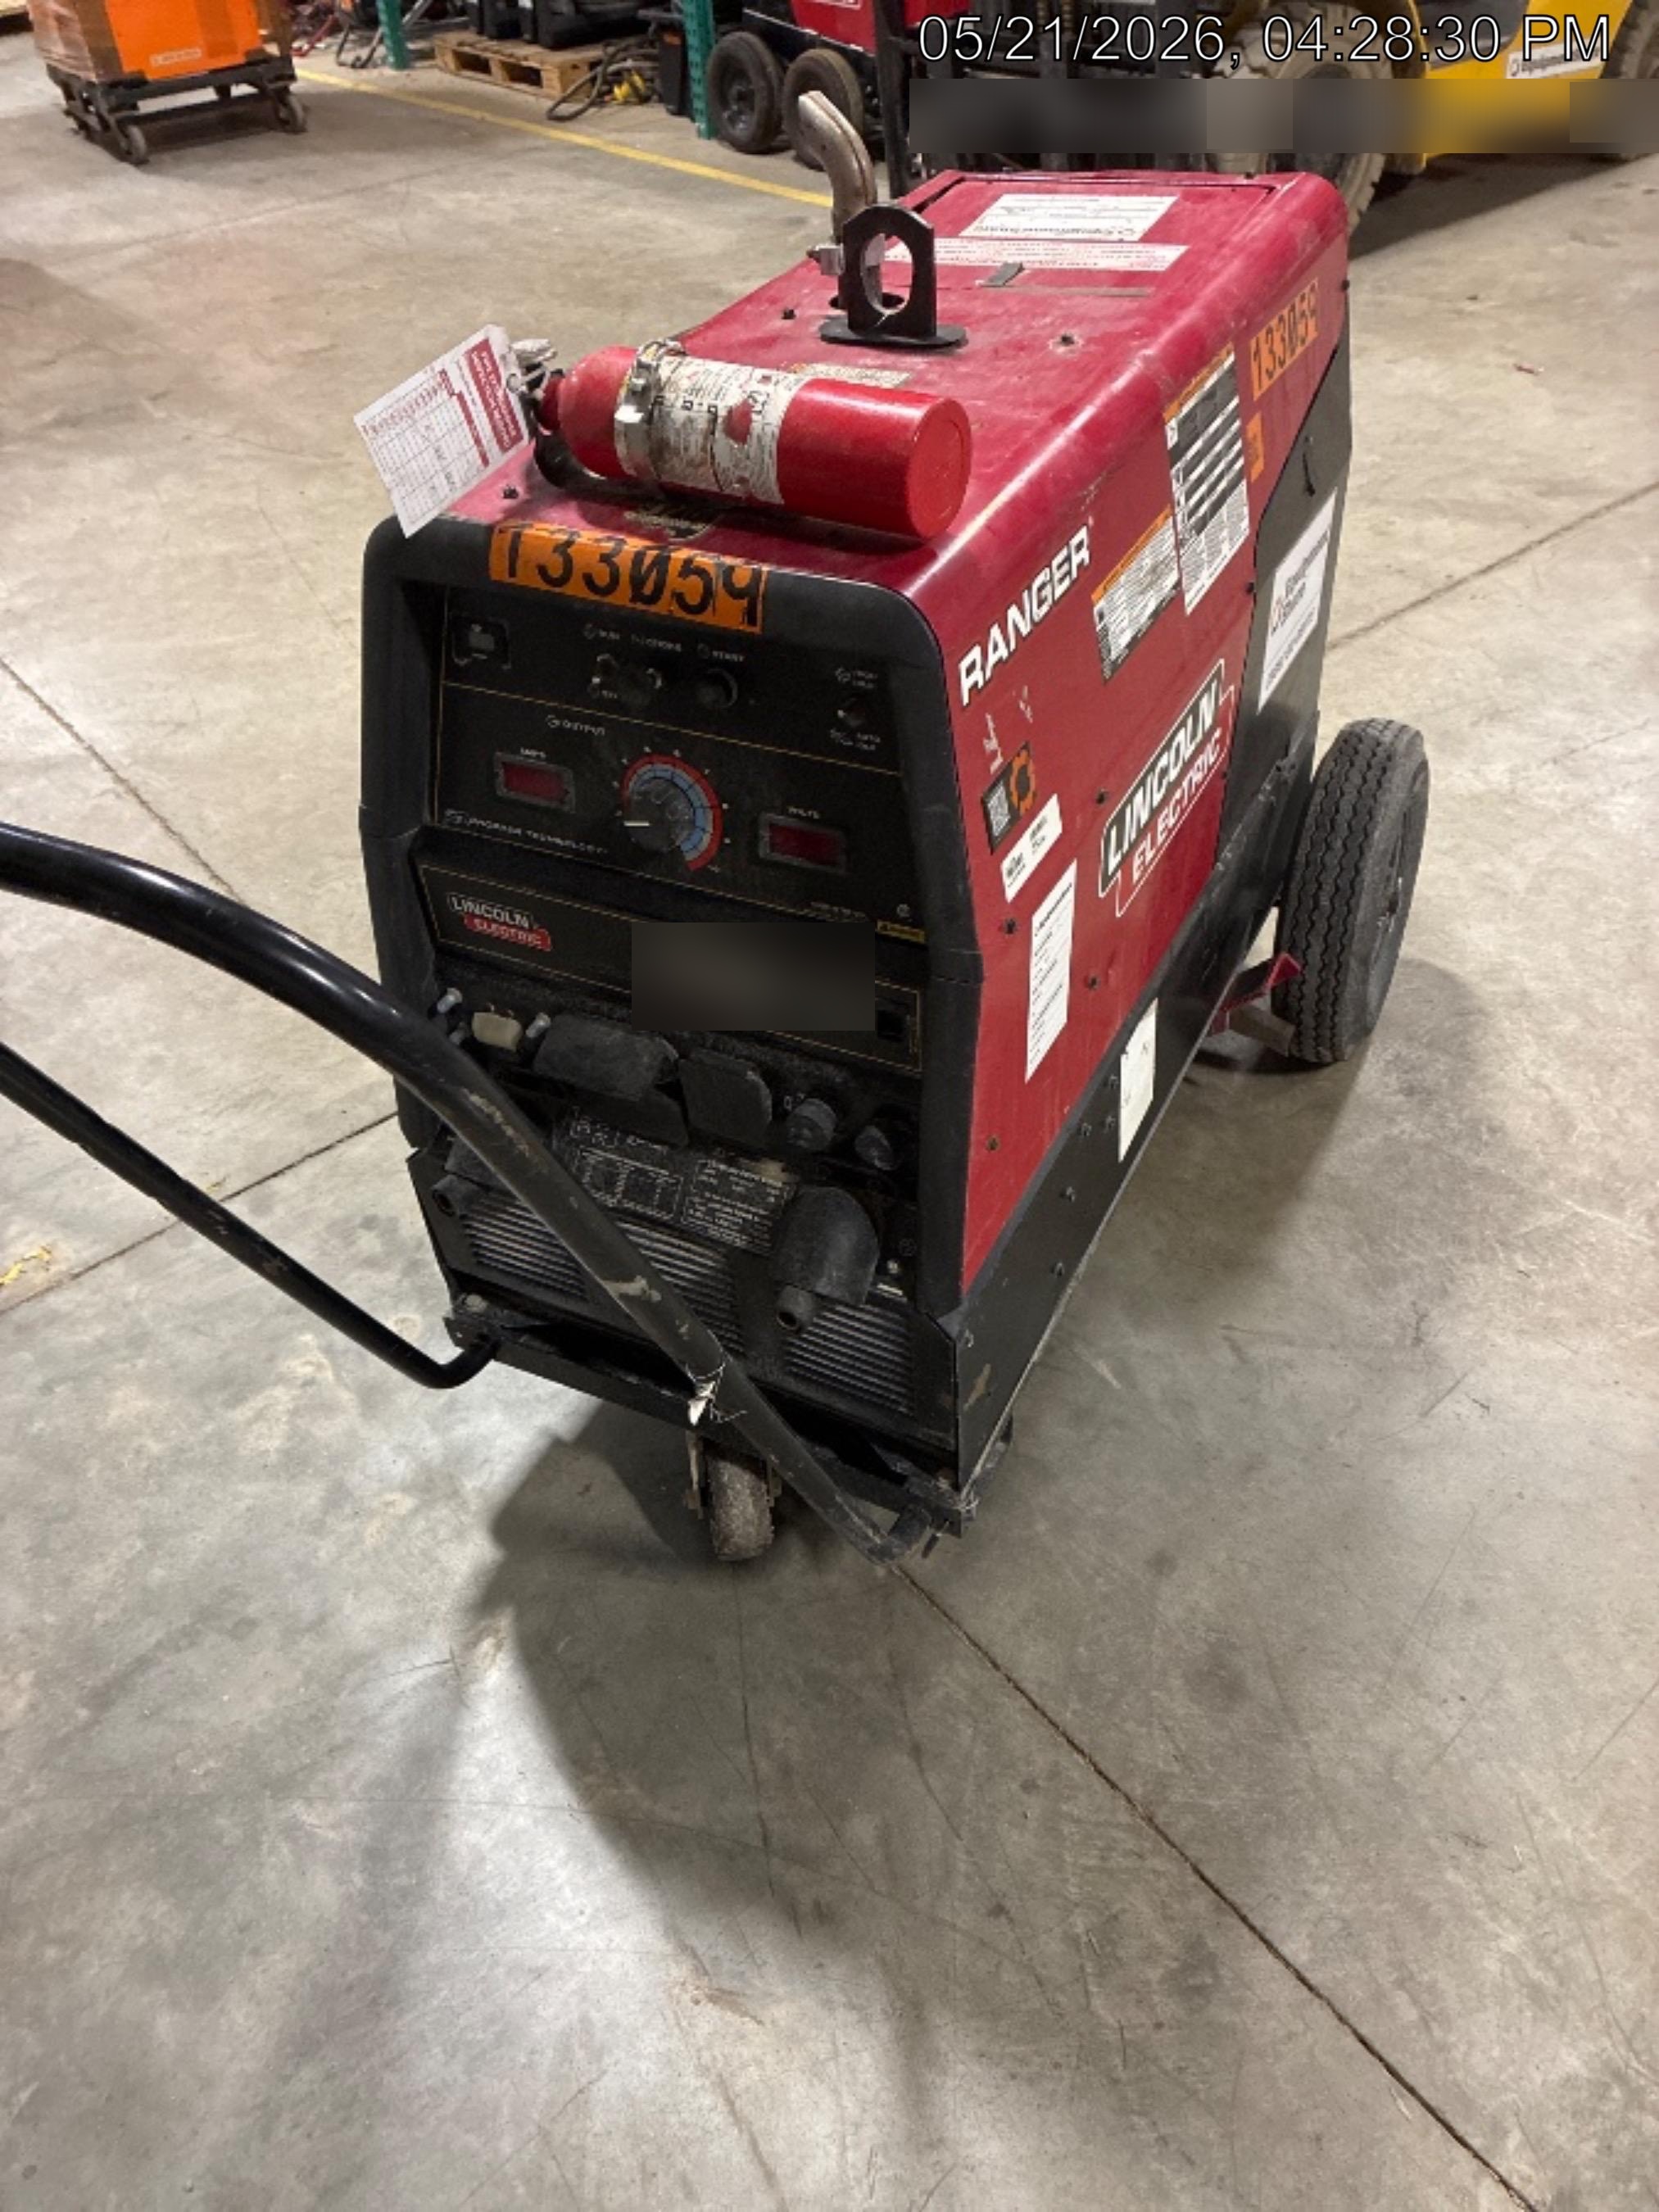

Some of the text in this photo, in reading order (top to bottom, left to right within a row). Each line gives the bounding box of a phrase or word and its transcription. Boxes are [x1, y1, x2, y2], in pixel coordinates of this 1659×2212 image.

[498, 524, 763, 627] 133059
[959, 525, 1090, 707] RANGER
[1108, 680, 1217, 876] LINCOLN
[1132, 727, 1222, 885] ELECTRIC
[451, 895, 530, 928] LINCOLN
[473, 918, 544, 950] ELECTRIC
